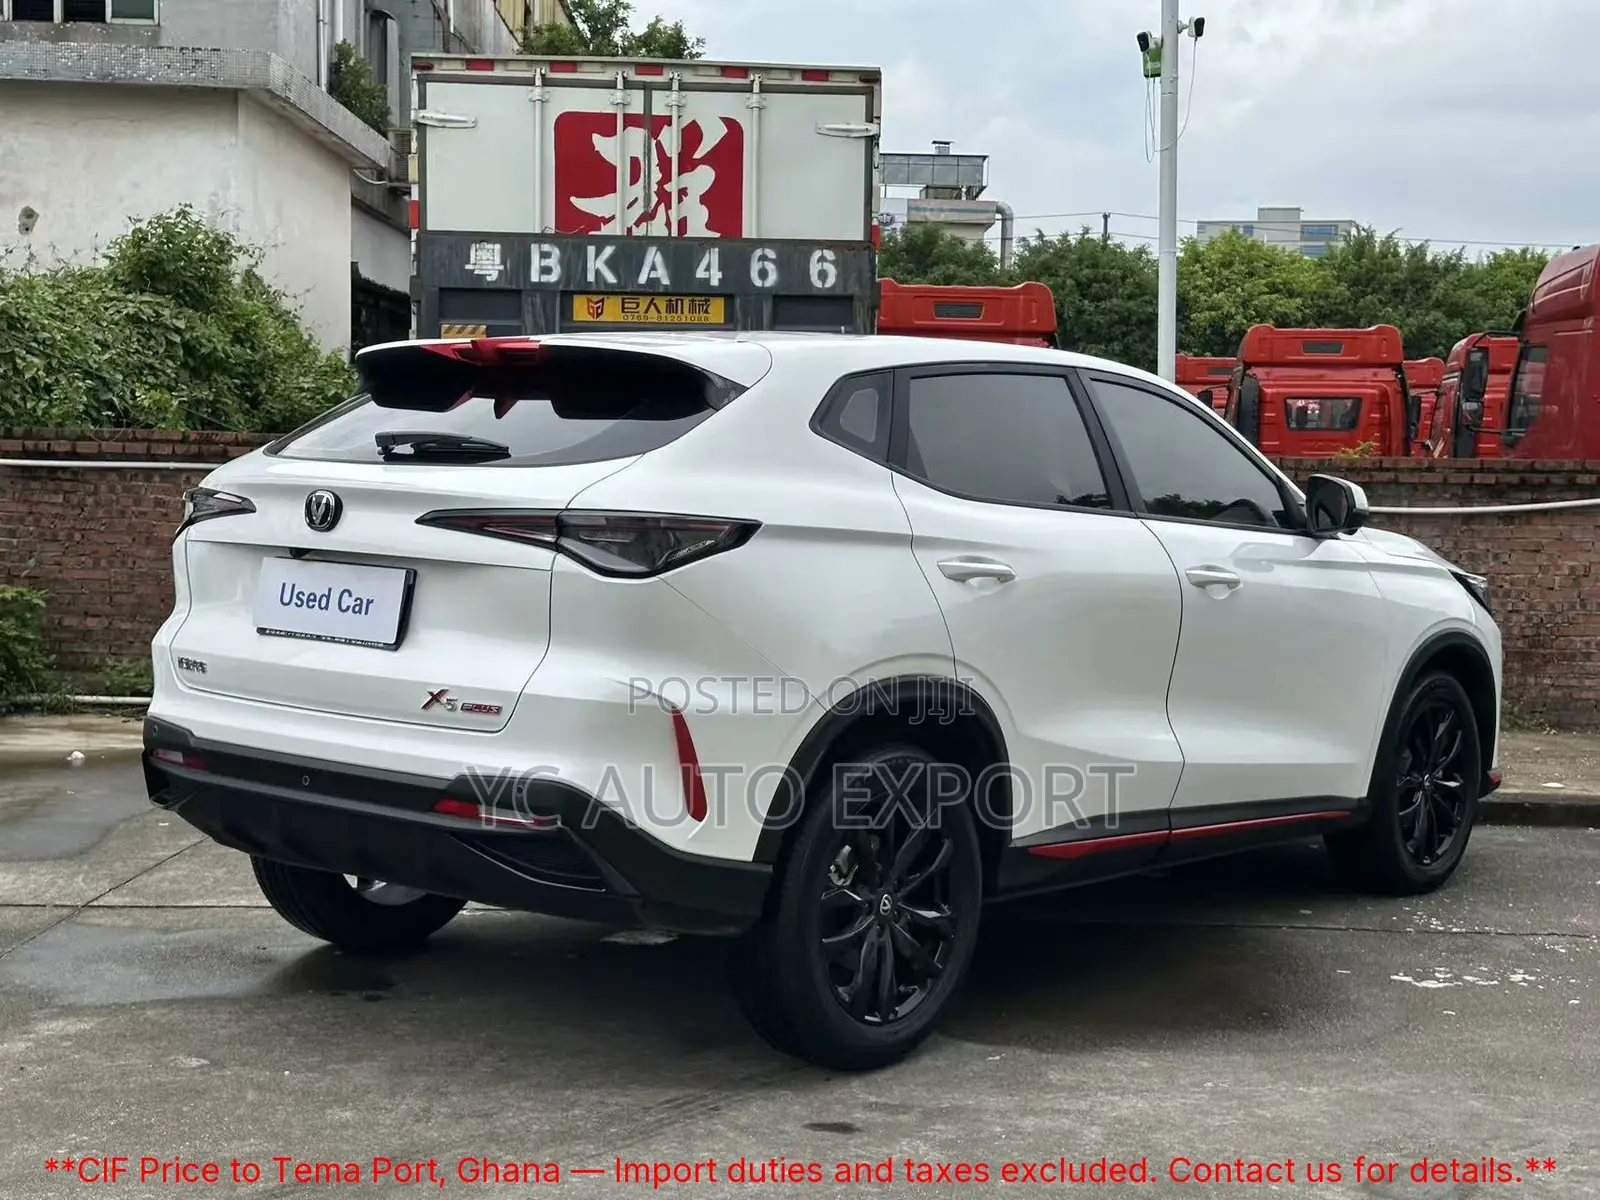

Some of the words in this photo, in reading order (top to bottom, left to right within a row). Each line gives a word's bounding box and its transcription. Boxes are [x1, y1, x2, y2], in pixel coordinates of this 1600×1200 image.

[621, 296, 711, 315] 巨人机械
[279, 582, 332, 611] Used
[337, 588, 374, 616] Car
[460, 703, 503, 716] PLUS
